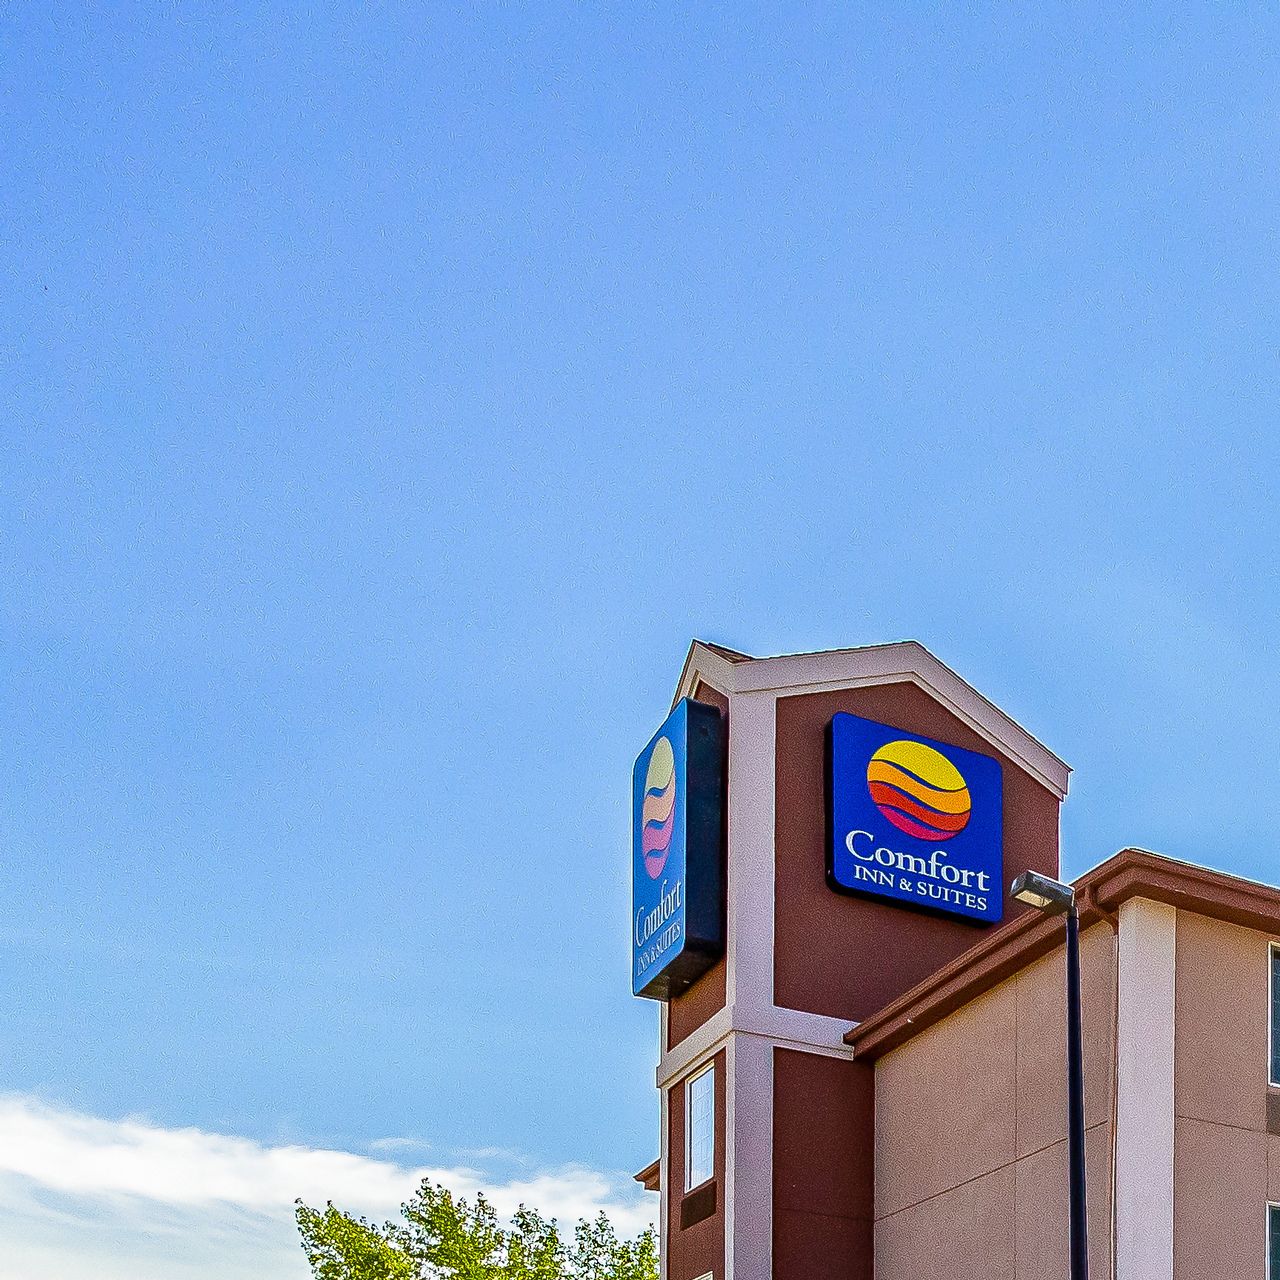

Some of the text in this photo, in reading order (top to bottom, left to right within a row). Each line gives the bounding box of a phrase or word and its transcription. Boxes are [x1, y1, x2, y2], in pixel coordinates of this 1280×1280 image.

[845, 830, 990, 891] Comfort
[853, 864, 987, 911] INN & SUITES
[636, 879, 682, 947] Comfort
[656, 919, 681, 954] SUITES
